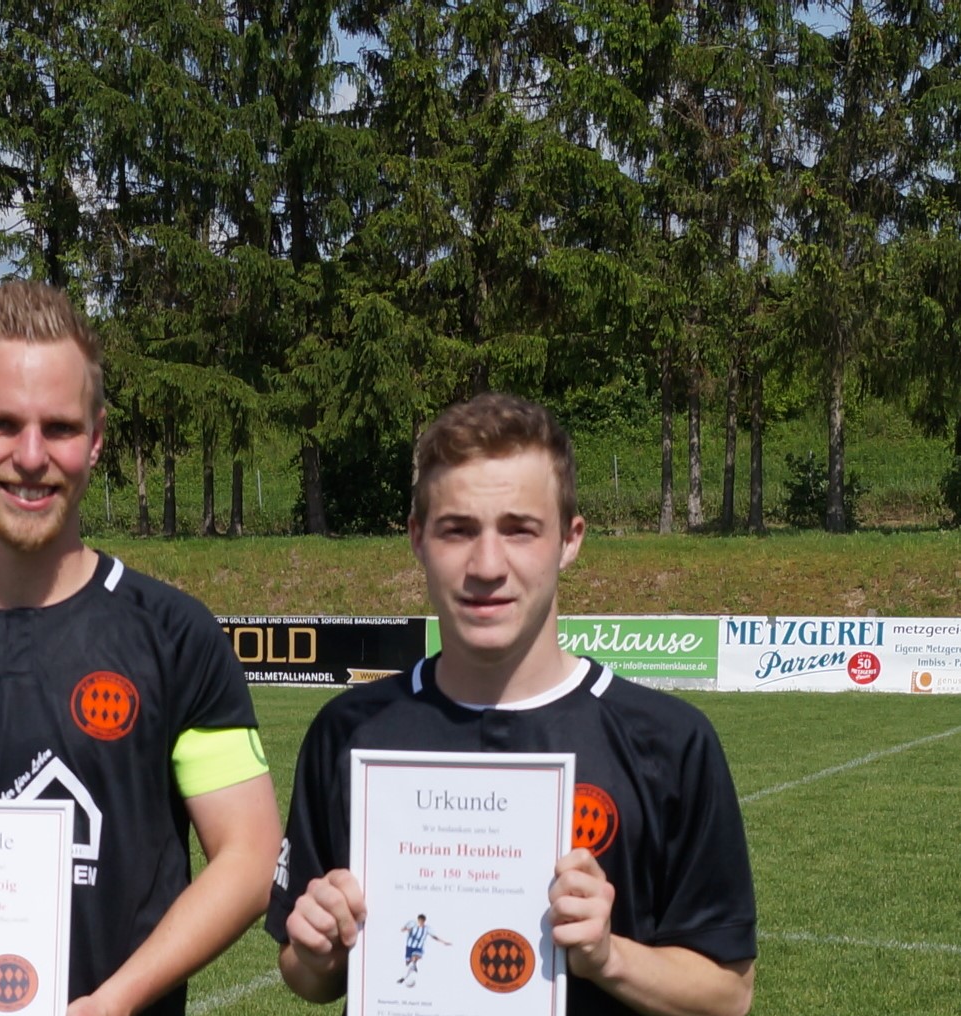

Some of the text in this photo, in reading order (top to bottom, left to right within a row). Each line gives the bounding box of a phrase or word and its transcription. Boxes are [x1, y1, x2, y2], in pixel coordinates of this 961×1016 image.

[229, 617, 247, 625] GOLD,
[282, 617, 320, 625] DIAMANTEN.
[725, 620, 885, 646] METZGEREI
[893, 624, 961, 637] metzgerei
[223, 627, 317, 663] OLD
[558, 624, 703, 654] enklause
[895, 644, 924, 656] Eigene
[622, 660, 708, 671] info@eremitenklause.de
[755, 649, 847, 679] Parzen
[856, 658, 872, 669] 50
[917, 657, 946, 667] Imbiss
[954, 658, 961, 667] P
[416, 789, 508, 812] Urkunde
[398, 841, 522, 859] Florian Heublein
[418, 867, 500, 882] für 150 Spiele
